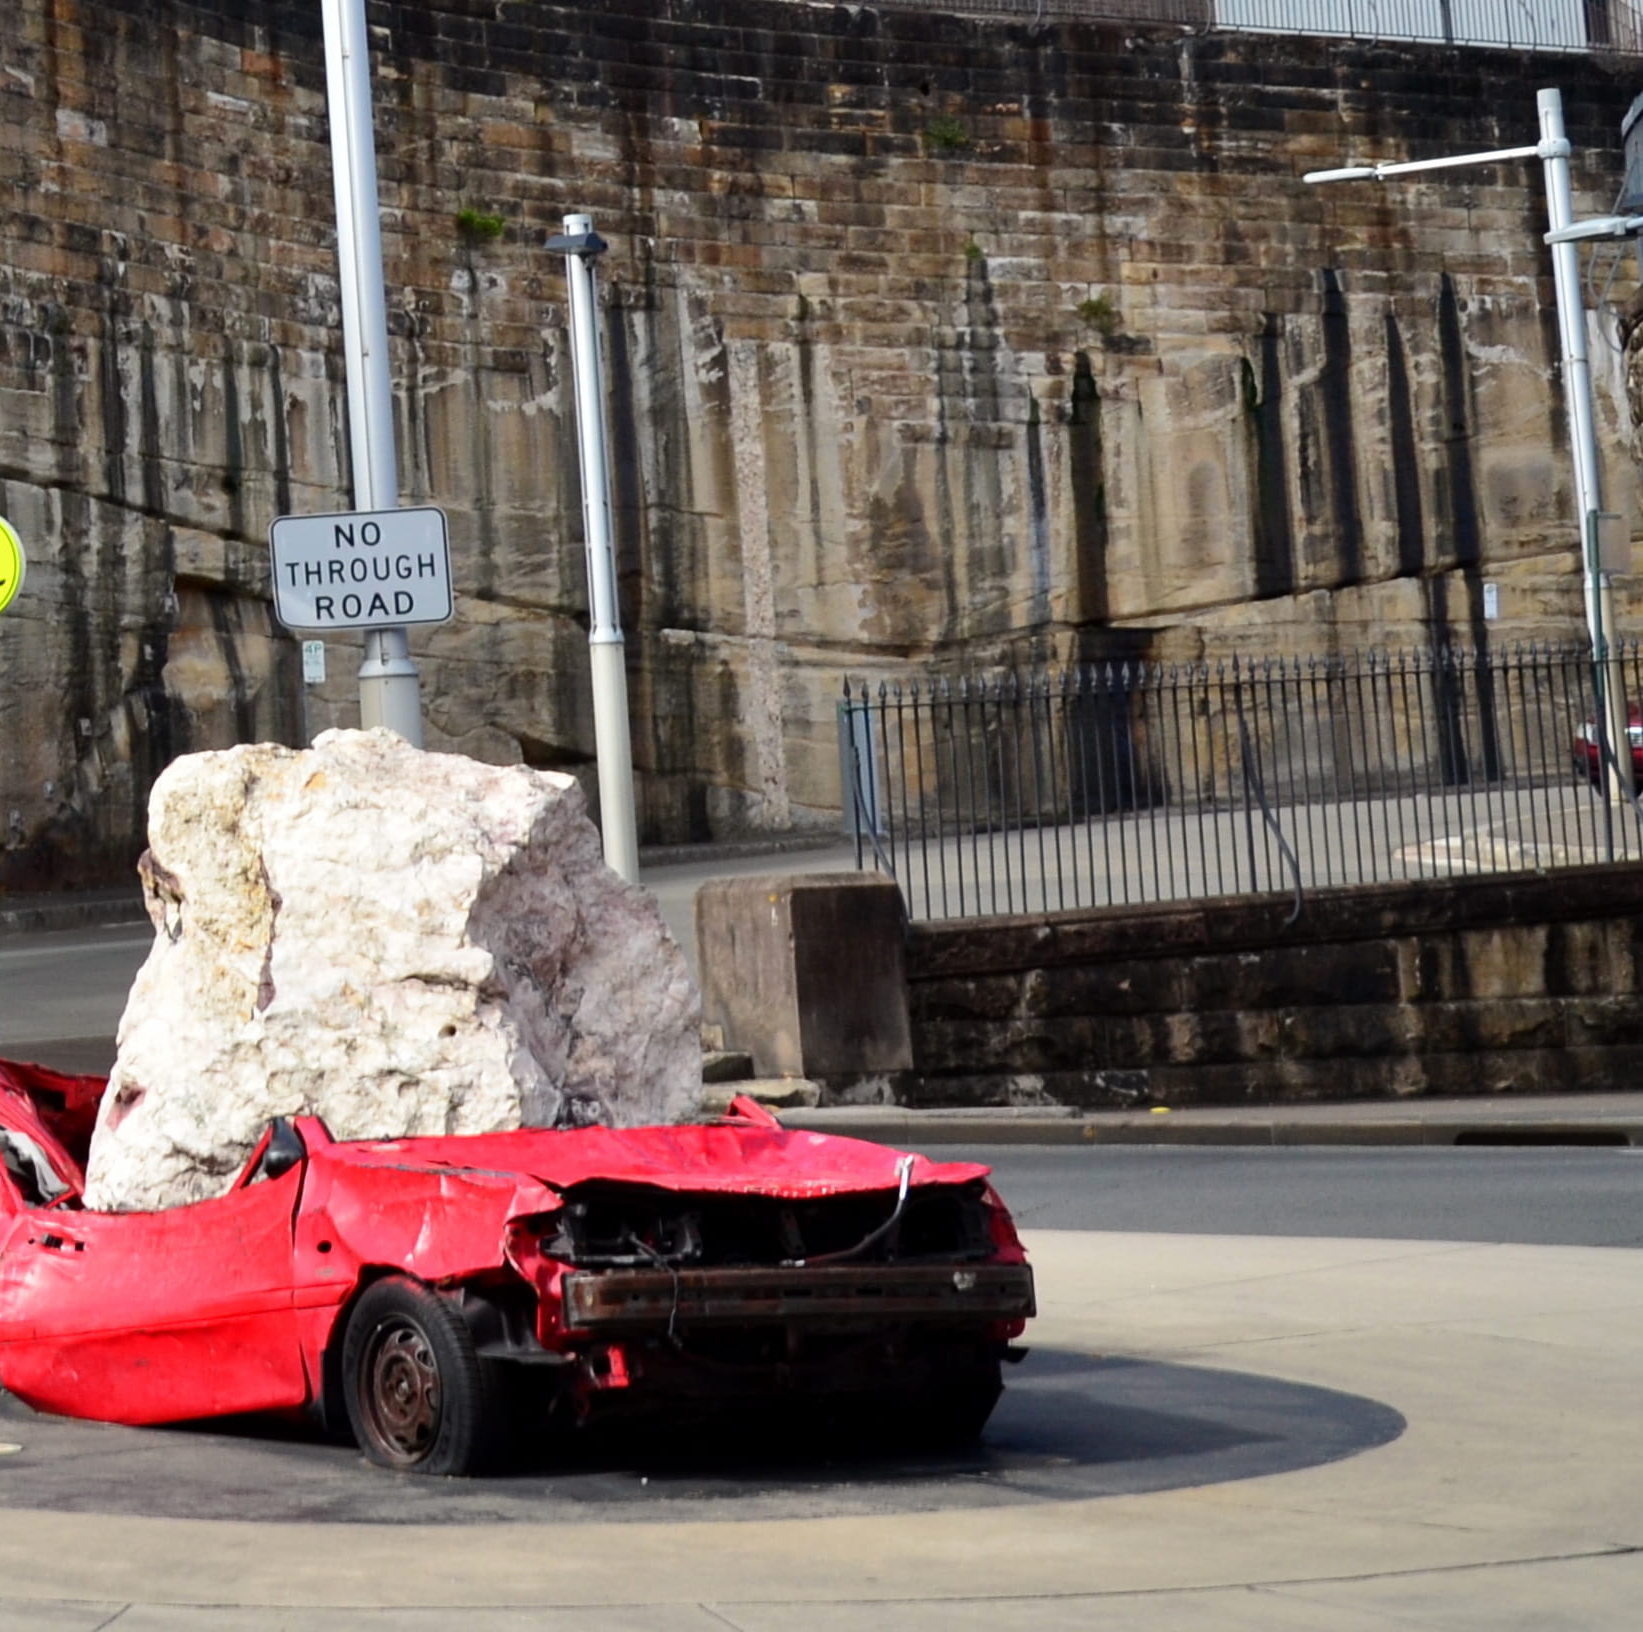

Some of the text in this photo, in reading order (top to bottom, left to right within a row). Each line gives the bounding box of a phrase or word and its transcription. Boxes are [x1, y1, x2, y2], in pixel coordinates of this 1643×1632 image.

[334, 522, 381, 548] NO
[285, 553, 436, 587] THROUGH
[315, 591, 414, 620] ROAD
